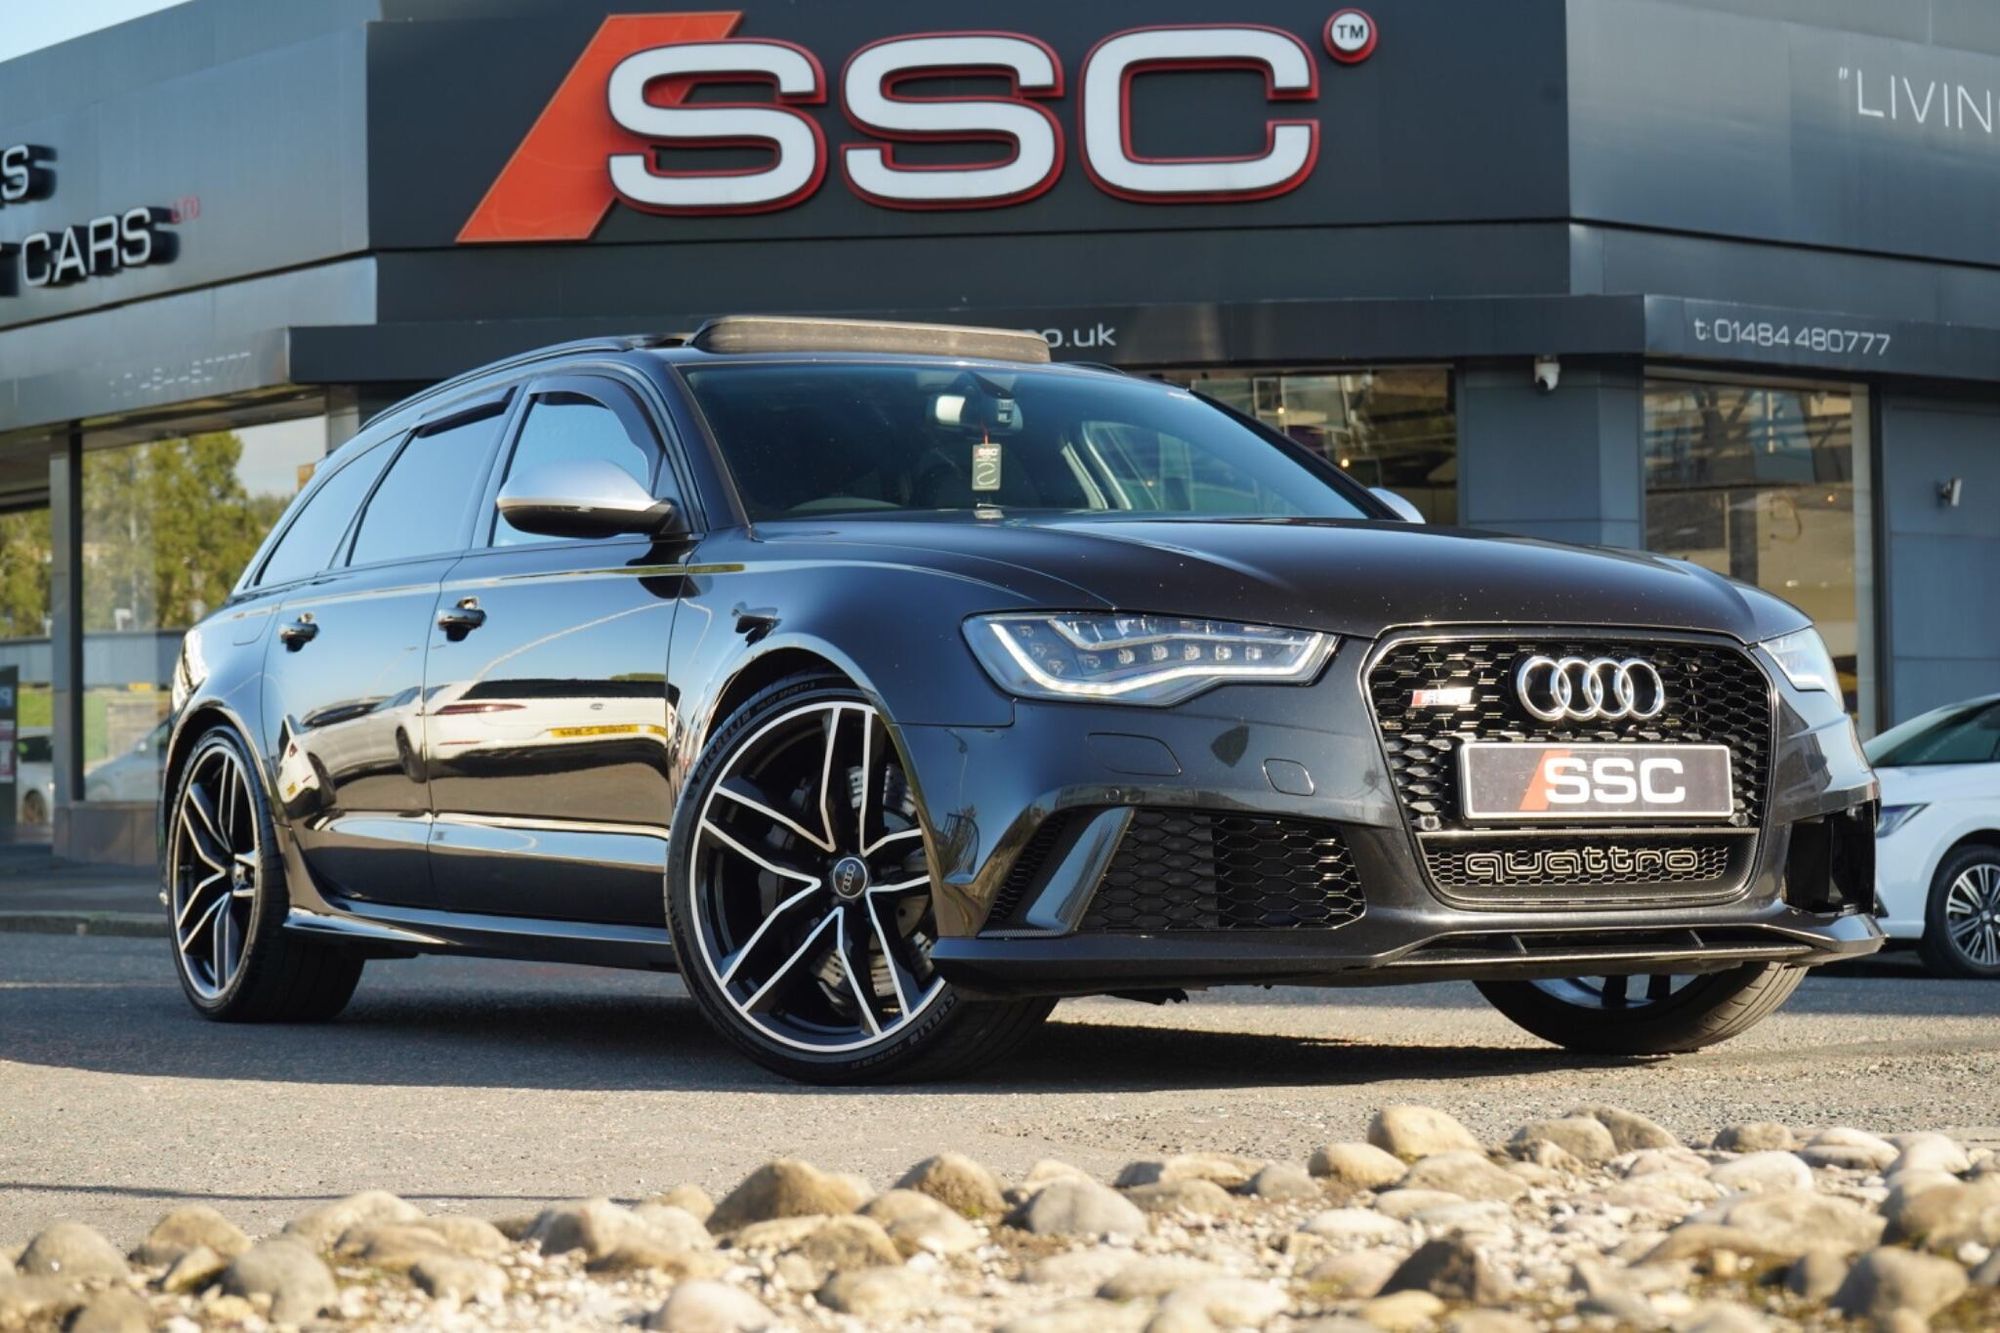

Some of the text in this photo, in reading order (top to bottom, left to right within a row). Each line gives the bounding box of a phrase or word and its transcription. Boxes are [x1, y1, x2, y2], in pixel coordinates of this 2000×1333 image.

[607, 24, 1364, 213] SSC TM
[22, 206, 151, 287] CARS
[1714, 319, 1790, 347] 01484
[1795, 327, 1891, 356] 480777
[1543, 756, 1686, 805] SSC
[1465, 846, 1699, 882] quattro
